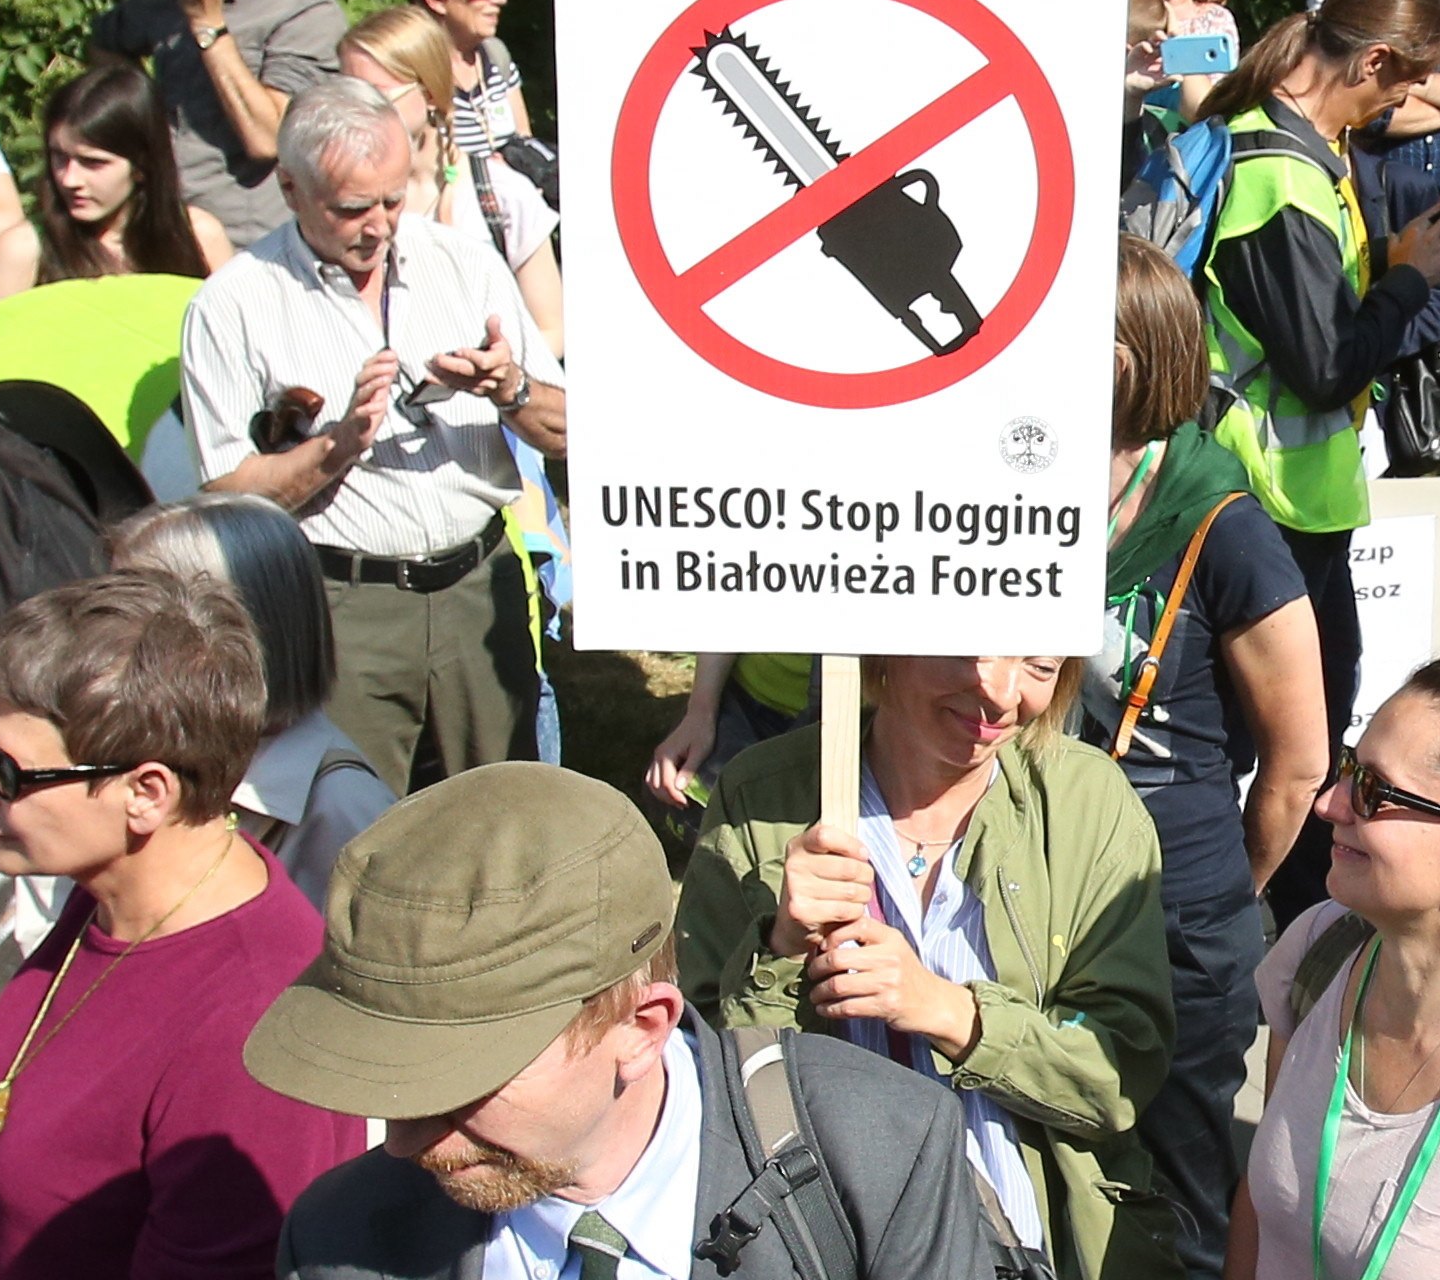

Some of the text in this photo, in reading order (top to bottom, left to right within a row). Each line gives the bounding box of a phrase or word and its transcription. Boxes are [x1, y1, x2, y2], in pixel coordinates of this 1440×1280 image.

[601, 485, 1081, 547] UNESCO! Stop logging
[620, 548, 1064, 597] in Białowieża Forest
